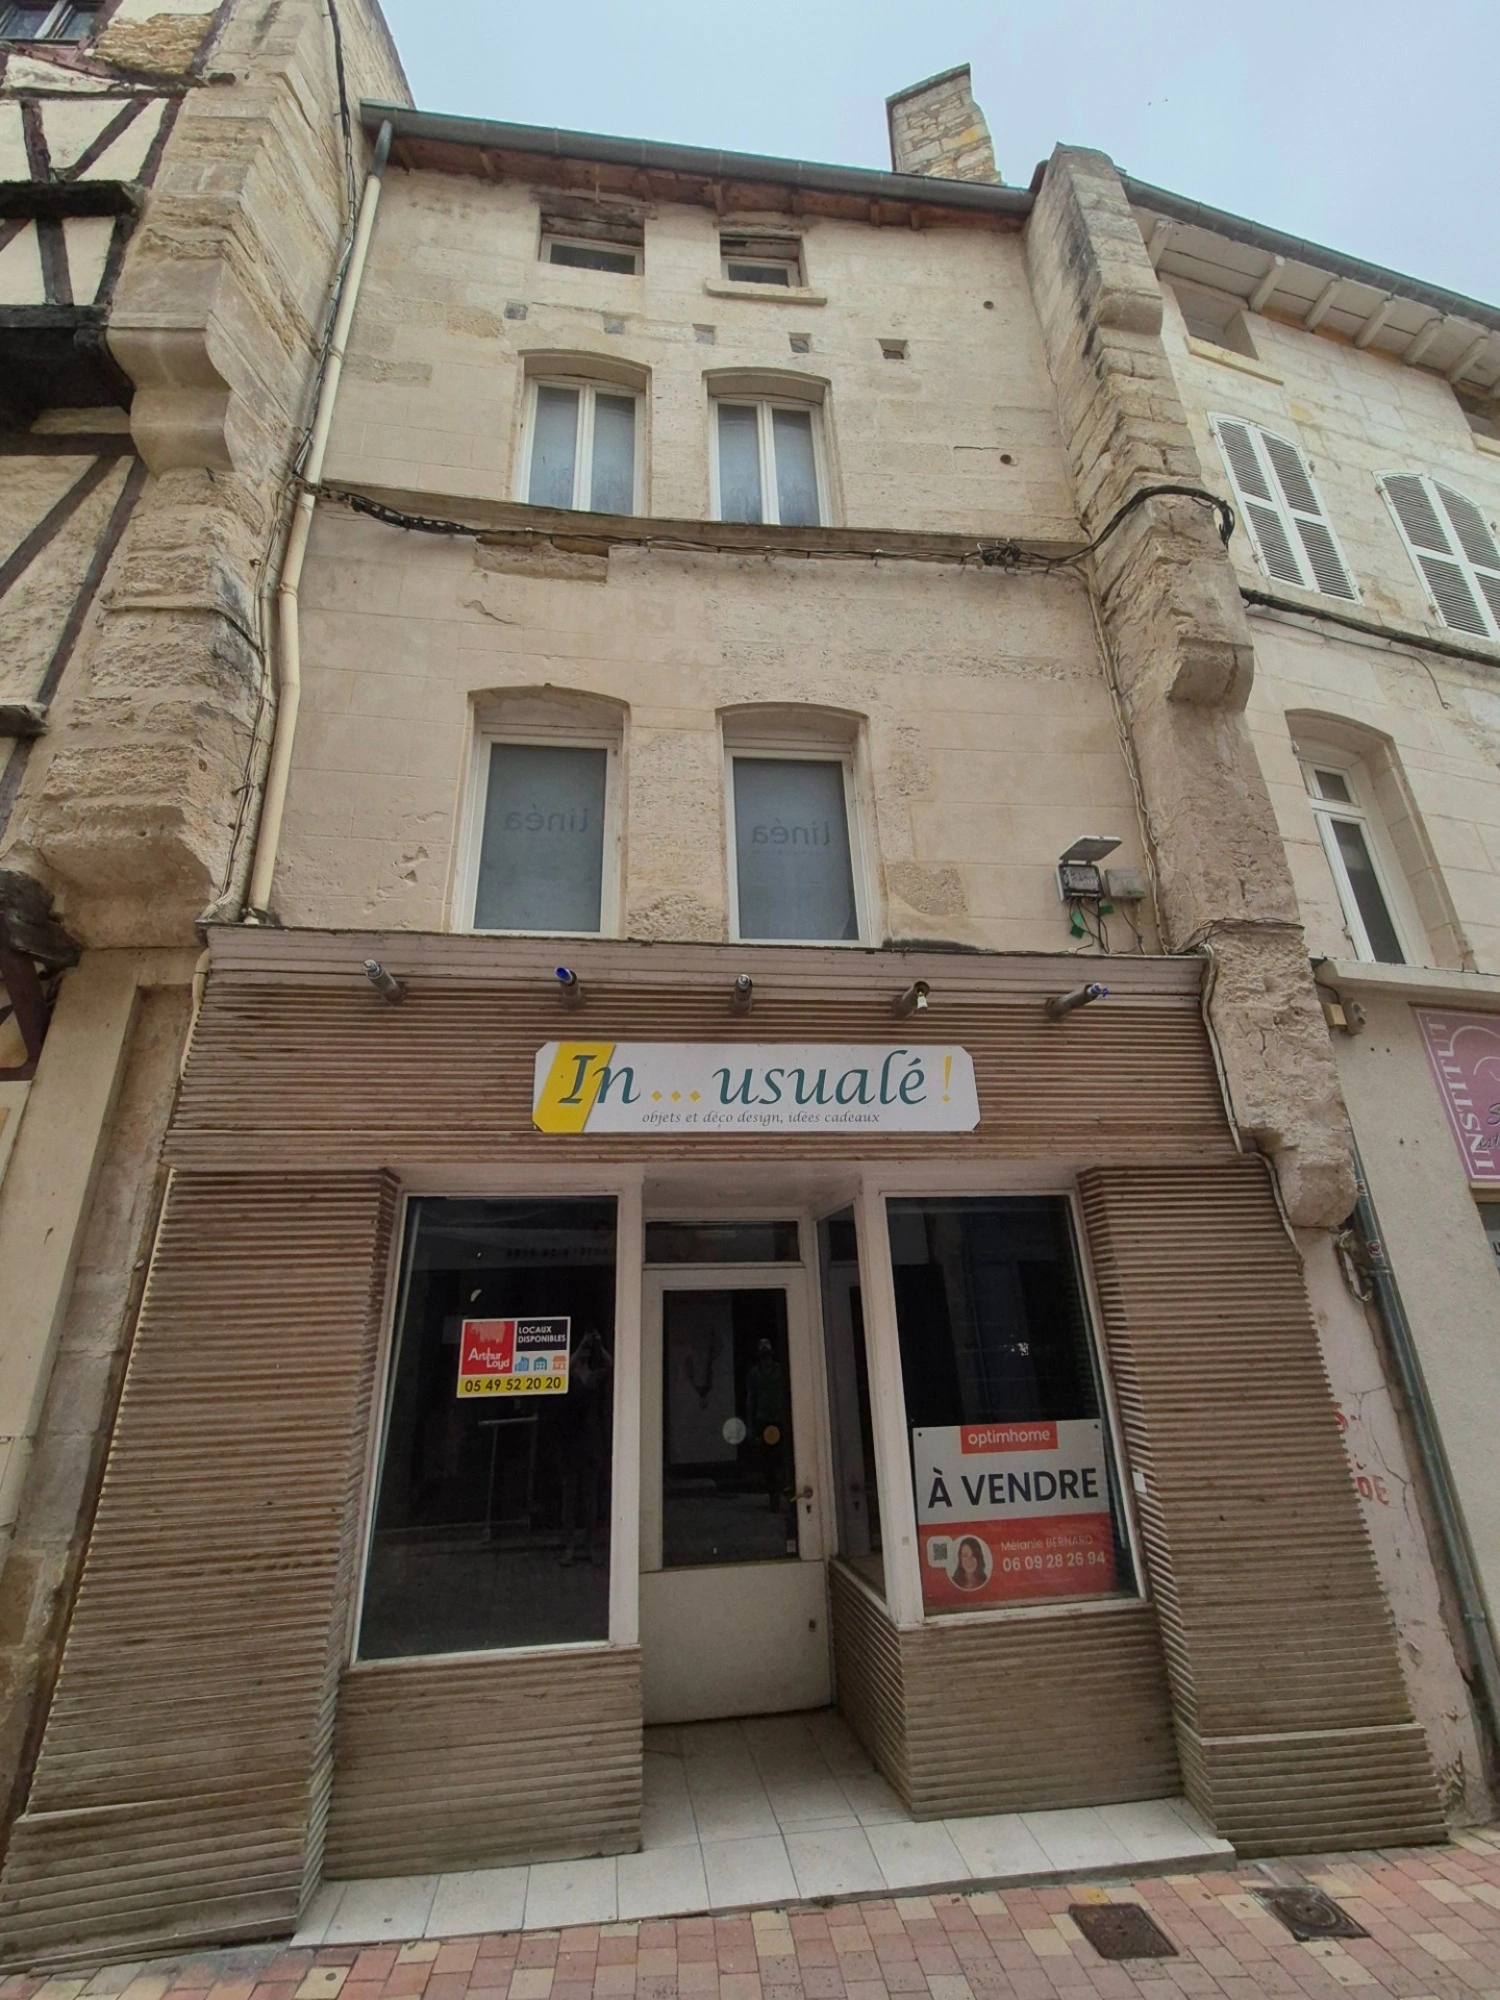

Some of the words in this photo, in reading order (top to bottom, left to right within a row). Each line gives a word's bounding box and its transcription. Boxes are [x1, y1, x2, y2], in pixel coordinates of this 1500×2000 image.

[712, 1050, 928, 1105] usualé
[1426, 1015, 1495, 1170] INSTITUT
[642, 1111, 681, 1126] objets
[685, 1112, 698, 1123] et
[737, 1111, 784, 1126] design,
[788, 1109, 821, 1123] idées
[824, 1110, 880, 1123] cadeaux
[518, 1326, 552, 1334] LOCAUX
[518, 1334, 566, 1344] DISPONIBLES
[468, 1347, 502, 1361] Arthur
[486, 1358, 510, 1370] Loyd
[465, 1380, 481, 1393] 05
[485, 1379, 502, 1391] 49
[506, 1378, 521, 1390] 52
[526, 1377, 541, 1389] 20
[545, 1376, 561, 1389] 20
[968, 1429, 1051, 1448] optimhome
[928, 1467, 952, 1508] À
[961, 1467, 1099, 1506] VENDRE
[1003, 1557, 1021, 1572] 06
[1024, 1555, 1042, 1570] 09
[1046, 1554, 1063, 1568] 28
[1066, 1552, 1084, 1567] 26
[1087, 1551, 1105, 1565] 94
